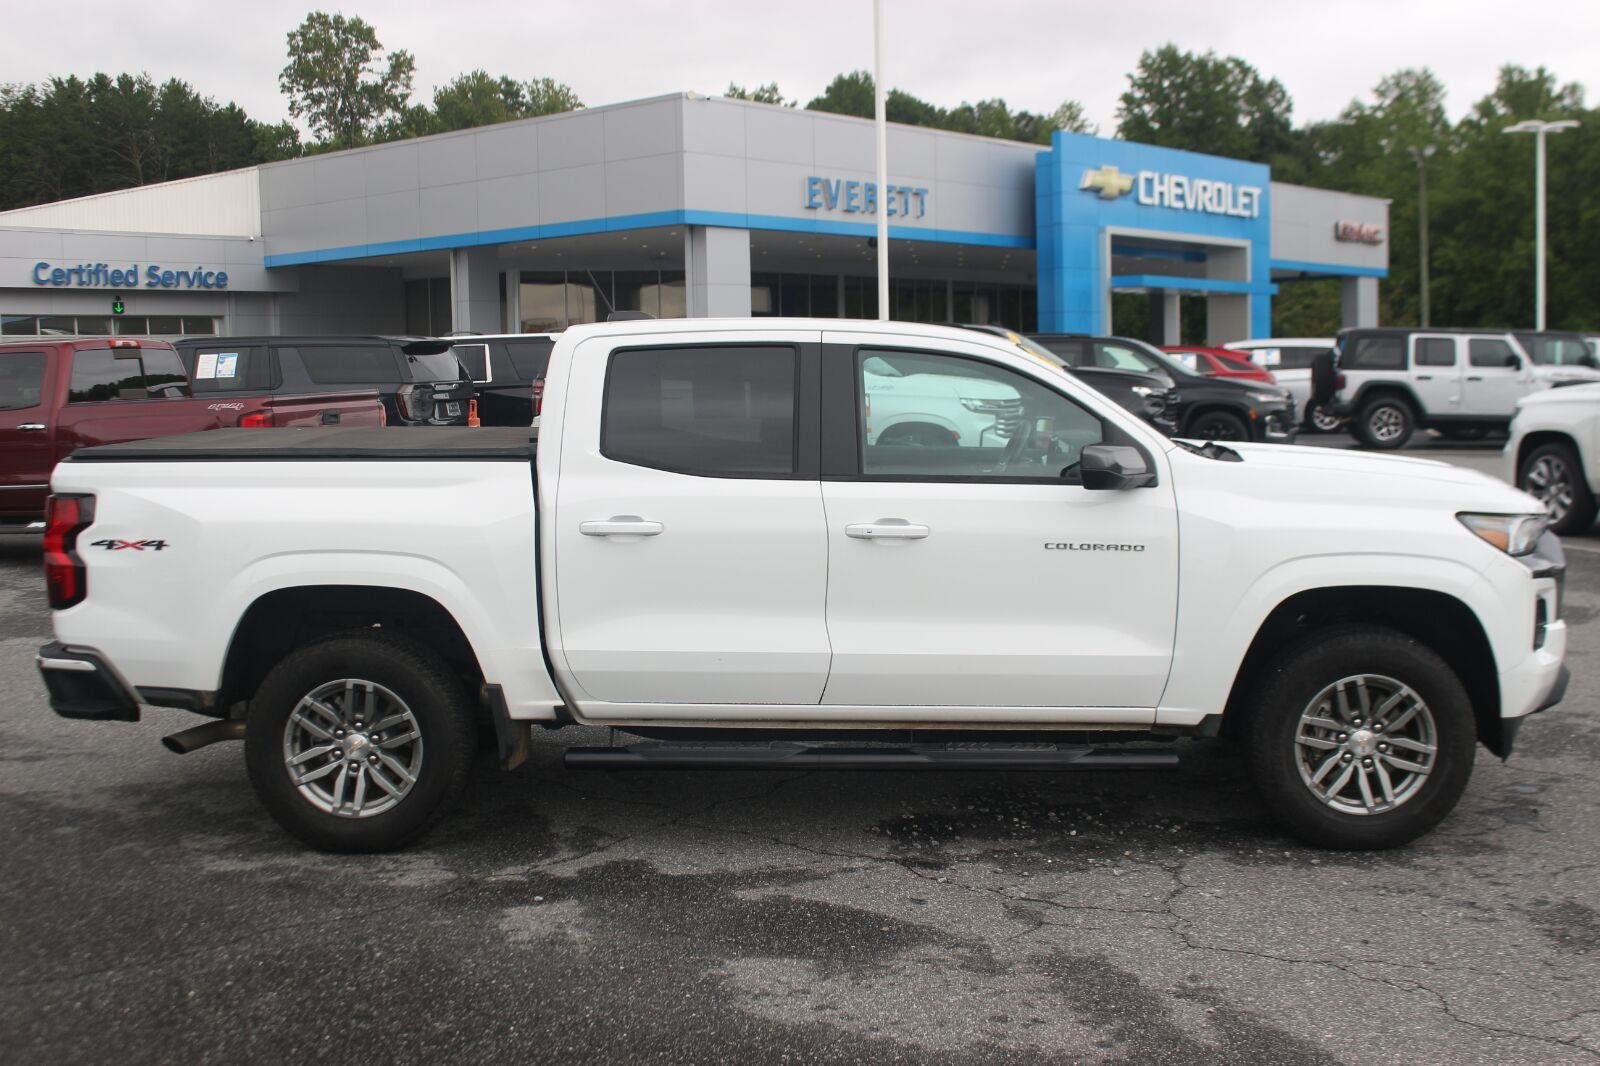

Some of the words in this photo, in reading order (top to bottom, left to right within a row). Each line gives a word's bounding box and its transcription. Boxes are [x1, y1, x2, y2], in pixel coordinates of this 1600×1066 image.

[804, 176, 929, 219] EVERETT
[1138, 170, 1262, 218] CHEVROLET
[33, 262, 139, 287] Certified
[146, 265, 229, 289] Service
[1044, 542, 1145, 552] COLORADO
